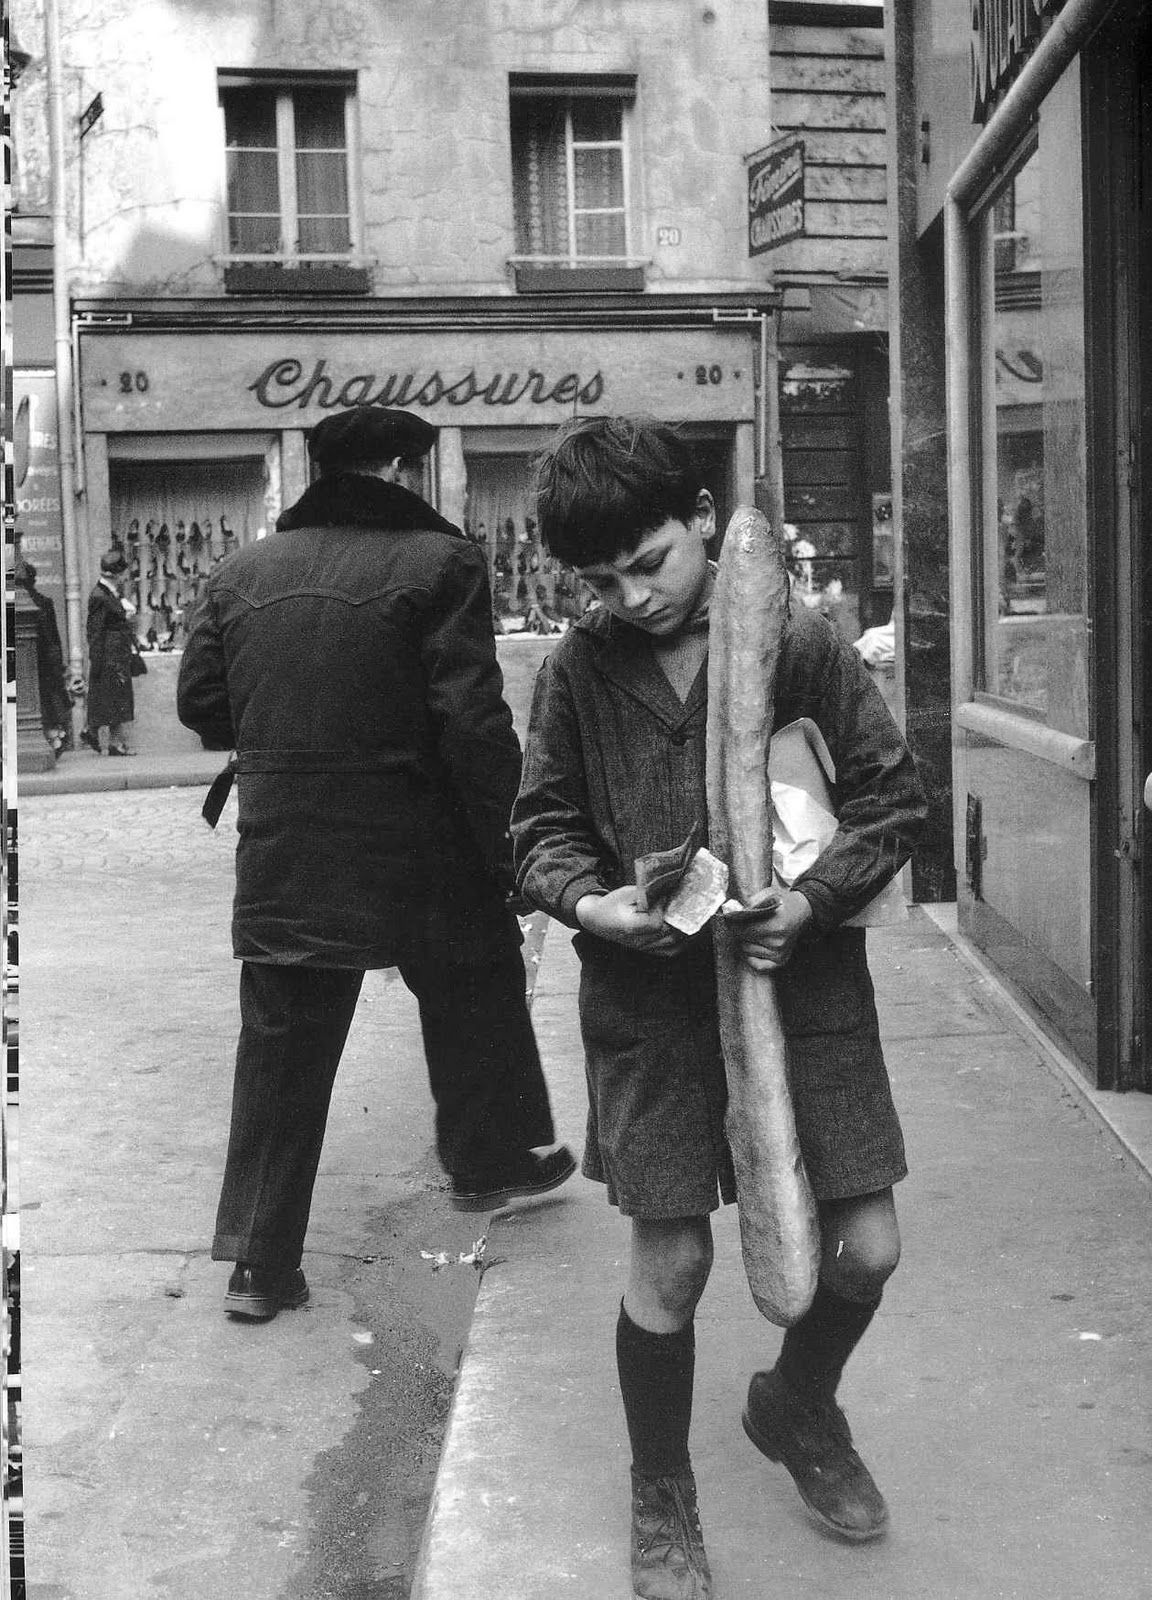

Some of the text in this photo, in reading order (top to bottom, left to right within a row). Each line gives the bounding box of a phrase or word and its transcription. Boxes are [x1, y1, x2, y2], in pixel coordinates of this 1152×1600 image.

[657, 226, 680, 247] 20
[119, 370, 149, 393] 20
[247, 358, 604, 408] Chaussures
[696, 364, 722, 385] 20
